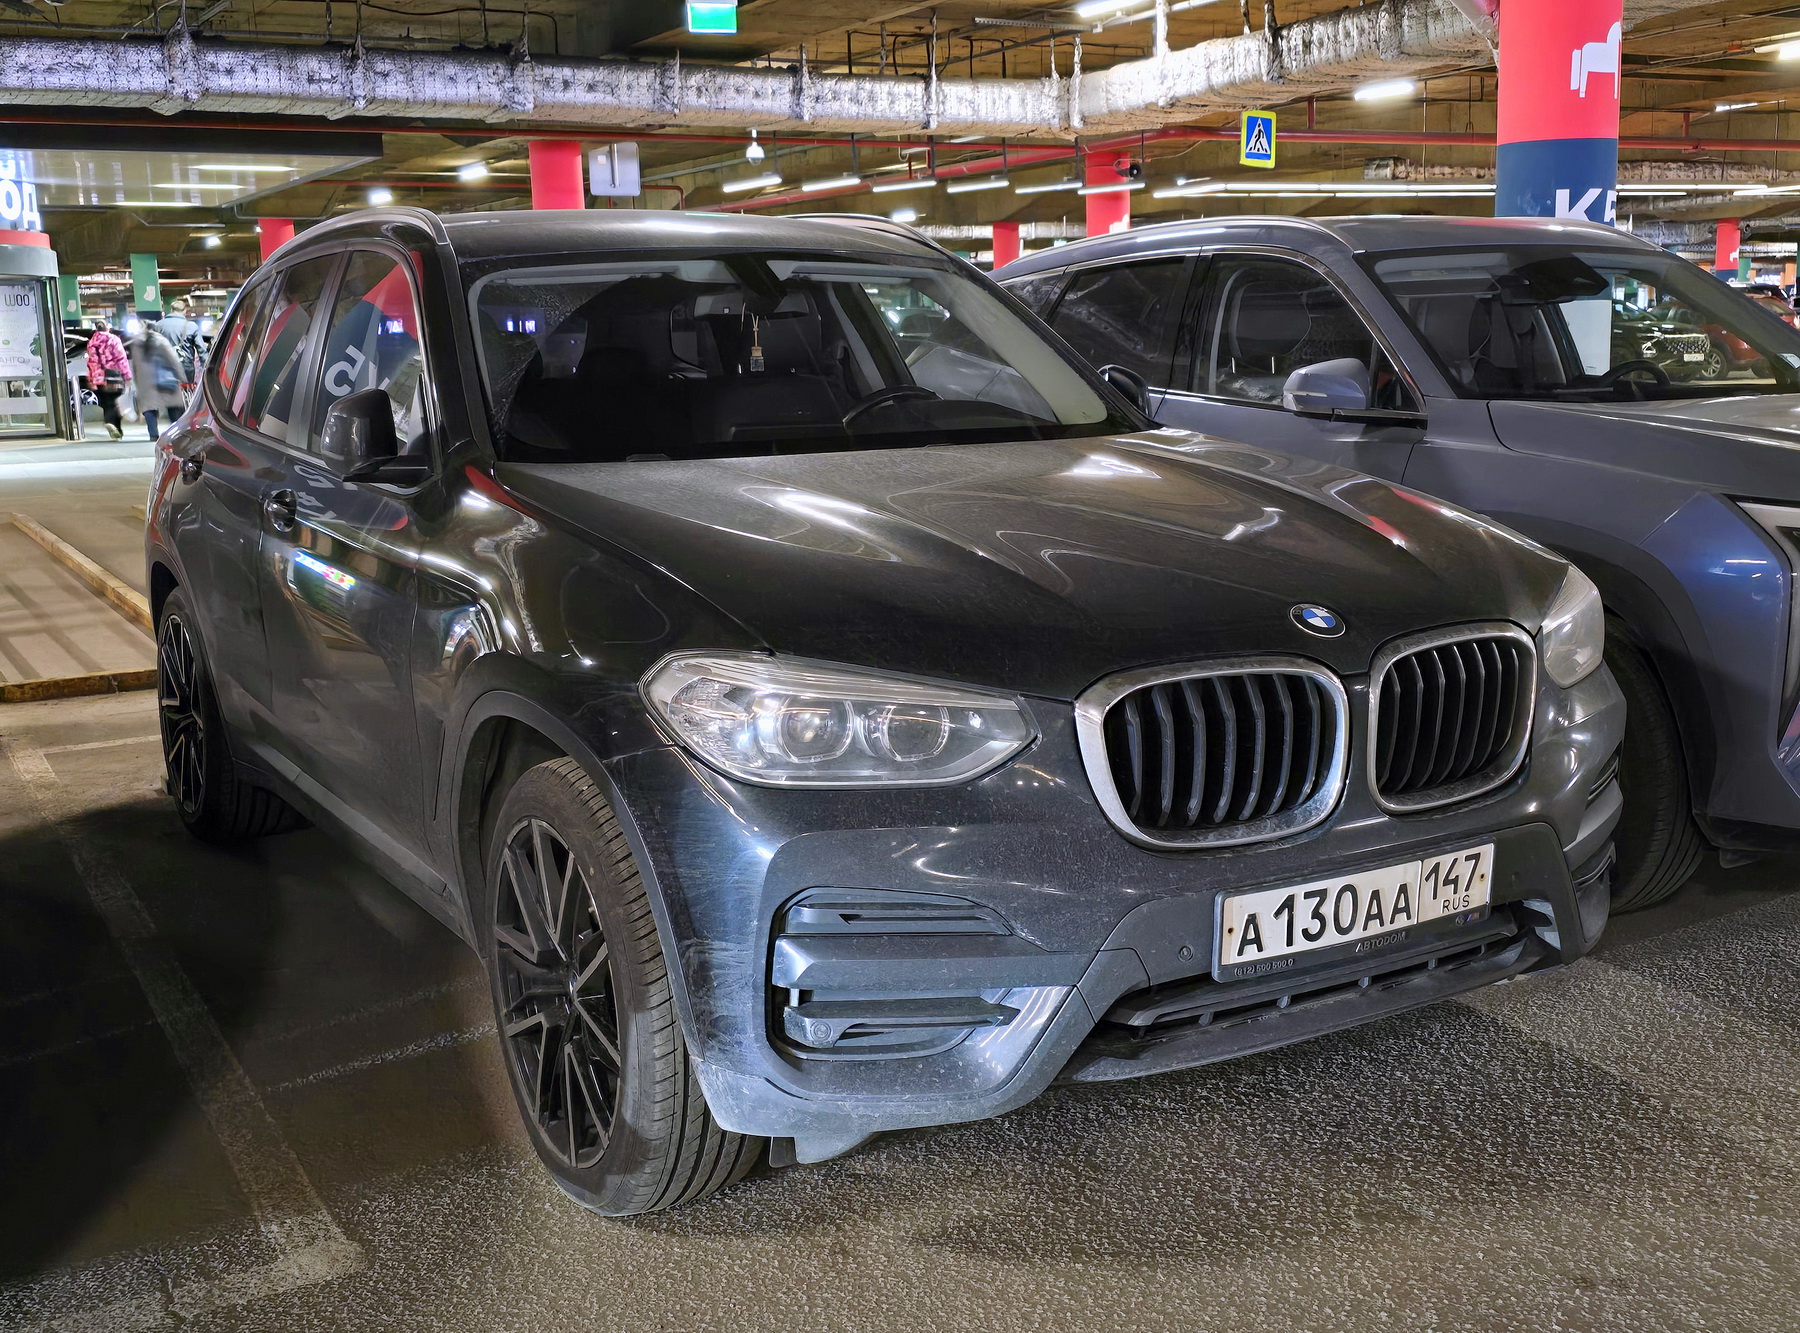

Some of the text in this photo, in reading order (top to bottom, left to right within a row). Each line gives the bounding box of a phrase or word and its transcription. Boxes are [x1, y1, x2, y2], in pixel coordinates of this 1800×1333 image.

[1424, 852, 1482, 901] 147
[1442, 896, 1470, 914] RUS
[1234, 963, 1255, 976] (812)
